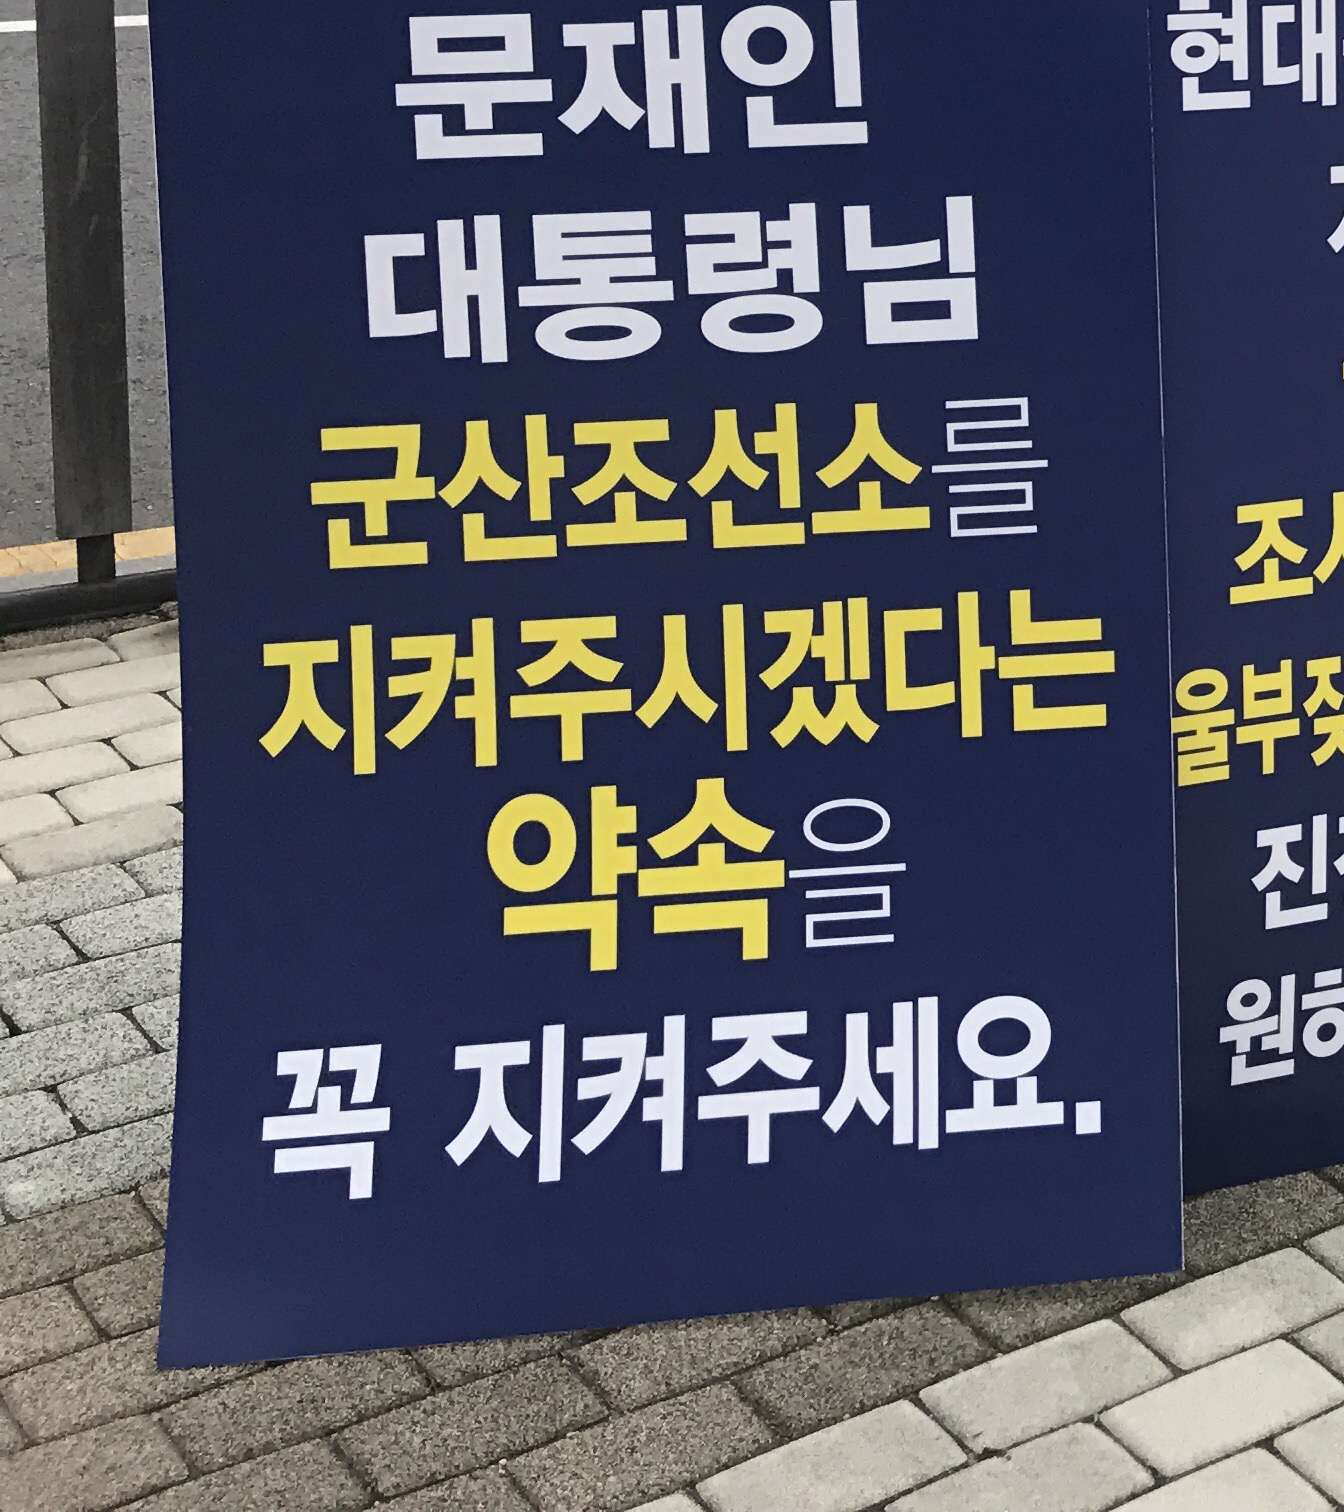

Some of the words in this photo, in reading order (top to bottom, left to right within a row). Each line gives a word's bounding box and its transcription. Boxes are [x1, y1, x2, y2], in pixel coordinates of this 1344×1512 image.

[395, 0, 868, 159] 문재인
[364, 196, 978, 363] 대통령님
[311, 397, 1048, 569] 군산조선소를
[259, 589, 1115, 775] 지켜주시겠다는
[487, 778, 906, 971] 약속을
[262, 1044, 390, 1199] 꼭
[445, 996, 1101, 1182] 지켜주세요.
